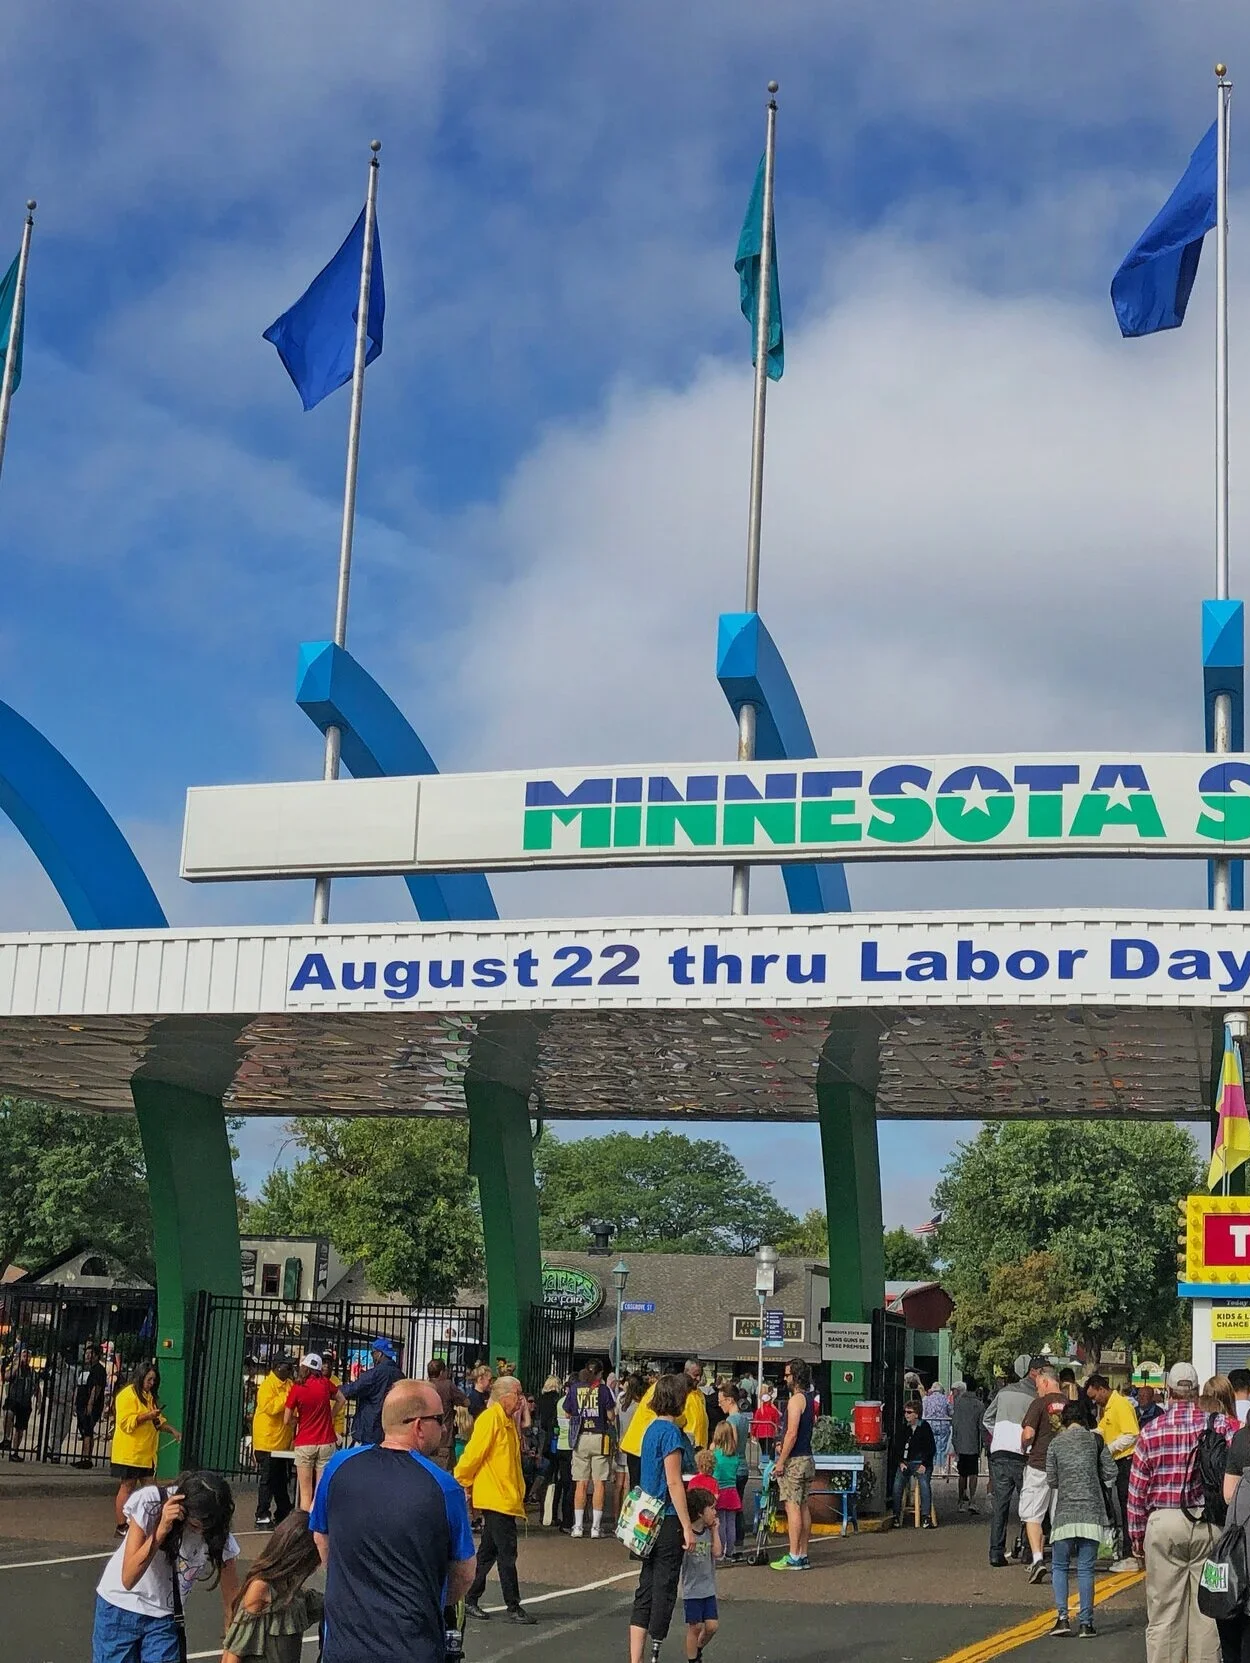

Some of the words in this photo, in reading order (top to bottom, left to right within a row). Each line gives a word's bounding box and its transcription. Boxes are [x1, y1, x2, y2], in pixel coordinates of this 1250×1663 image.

[523, 764, 1167, 850] MINNESOTA
[289, 948, 540, 999] August
[551, 944, 640, 987] 22
[668, 945, 827, 985] thru
[860, 940, 1088, 982] Labor
